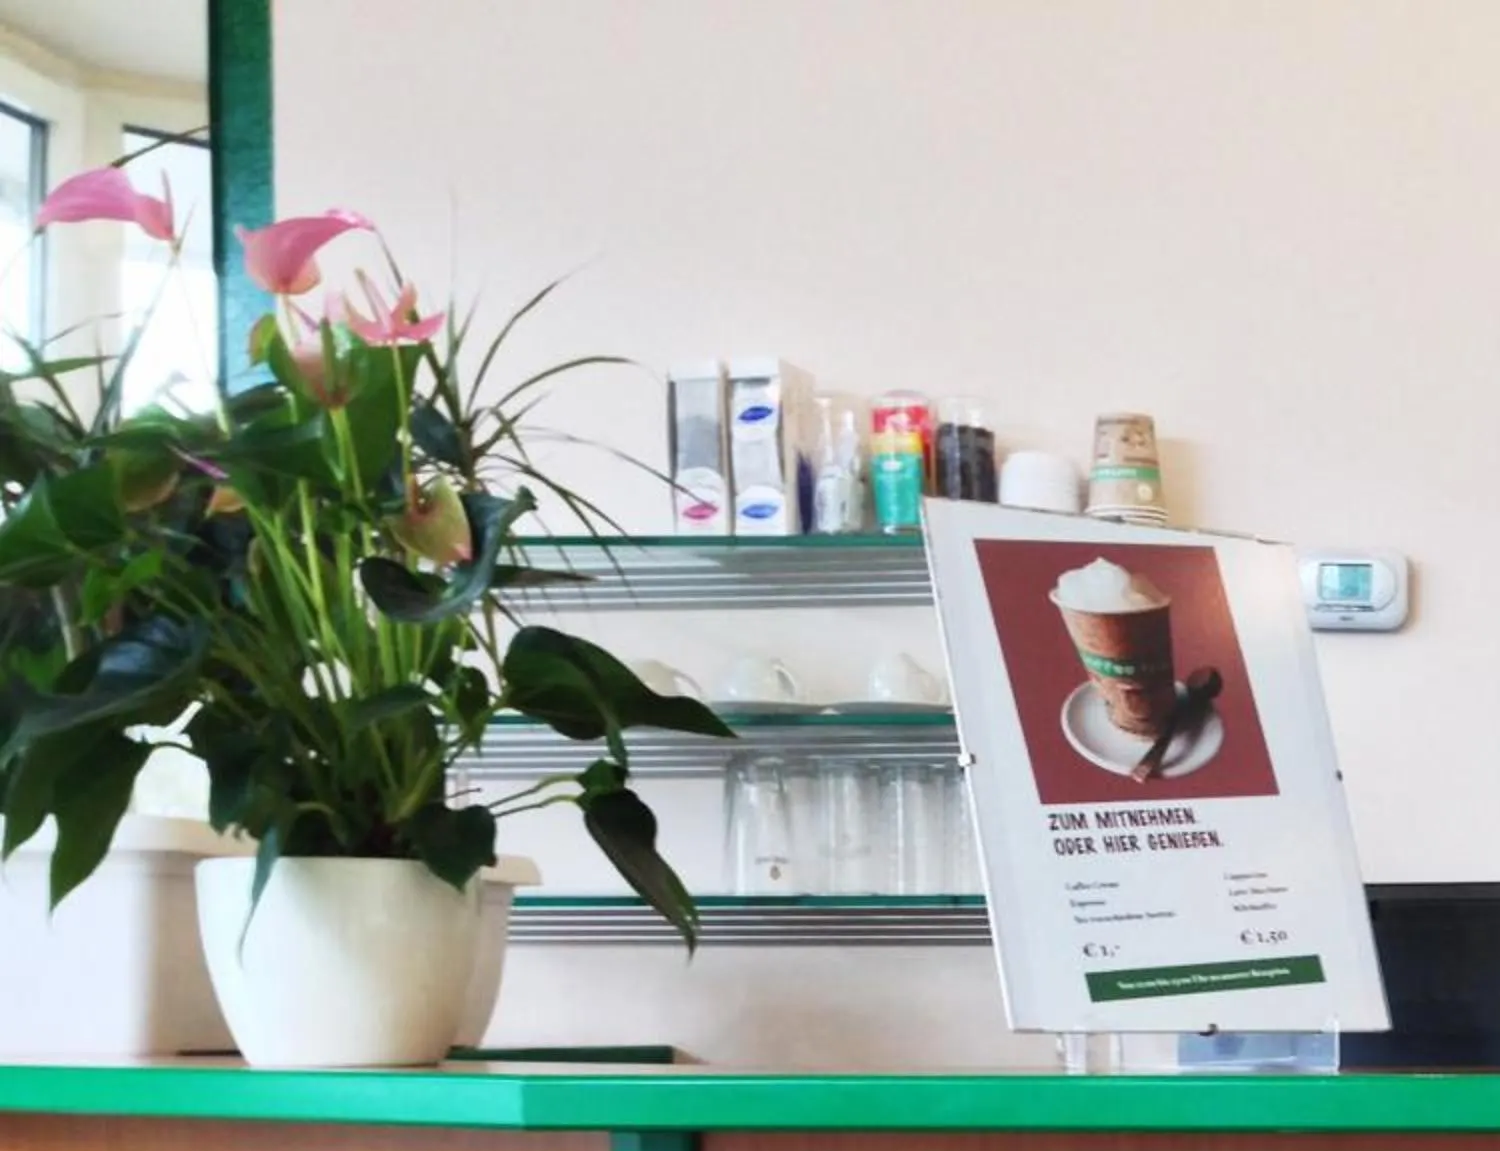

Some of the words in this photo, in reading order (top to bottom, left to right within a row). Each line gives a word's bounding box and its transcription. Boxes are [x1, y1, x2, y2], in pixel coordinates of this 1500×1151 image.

[1047, 811, 1089, 831] ZUM
[1053, 836, 1098, 856] ODER
[1102, 834, 1141, 854] HIER
